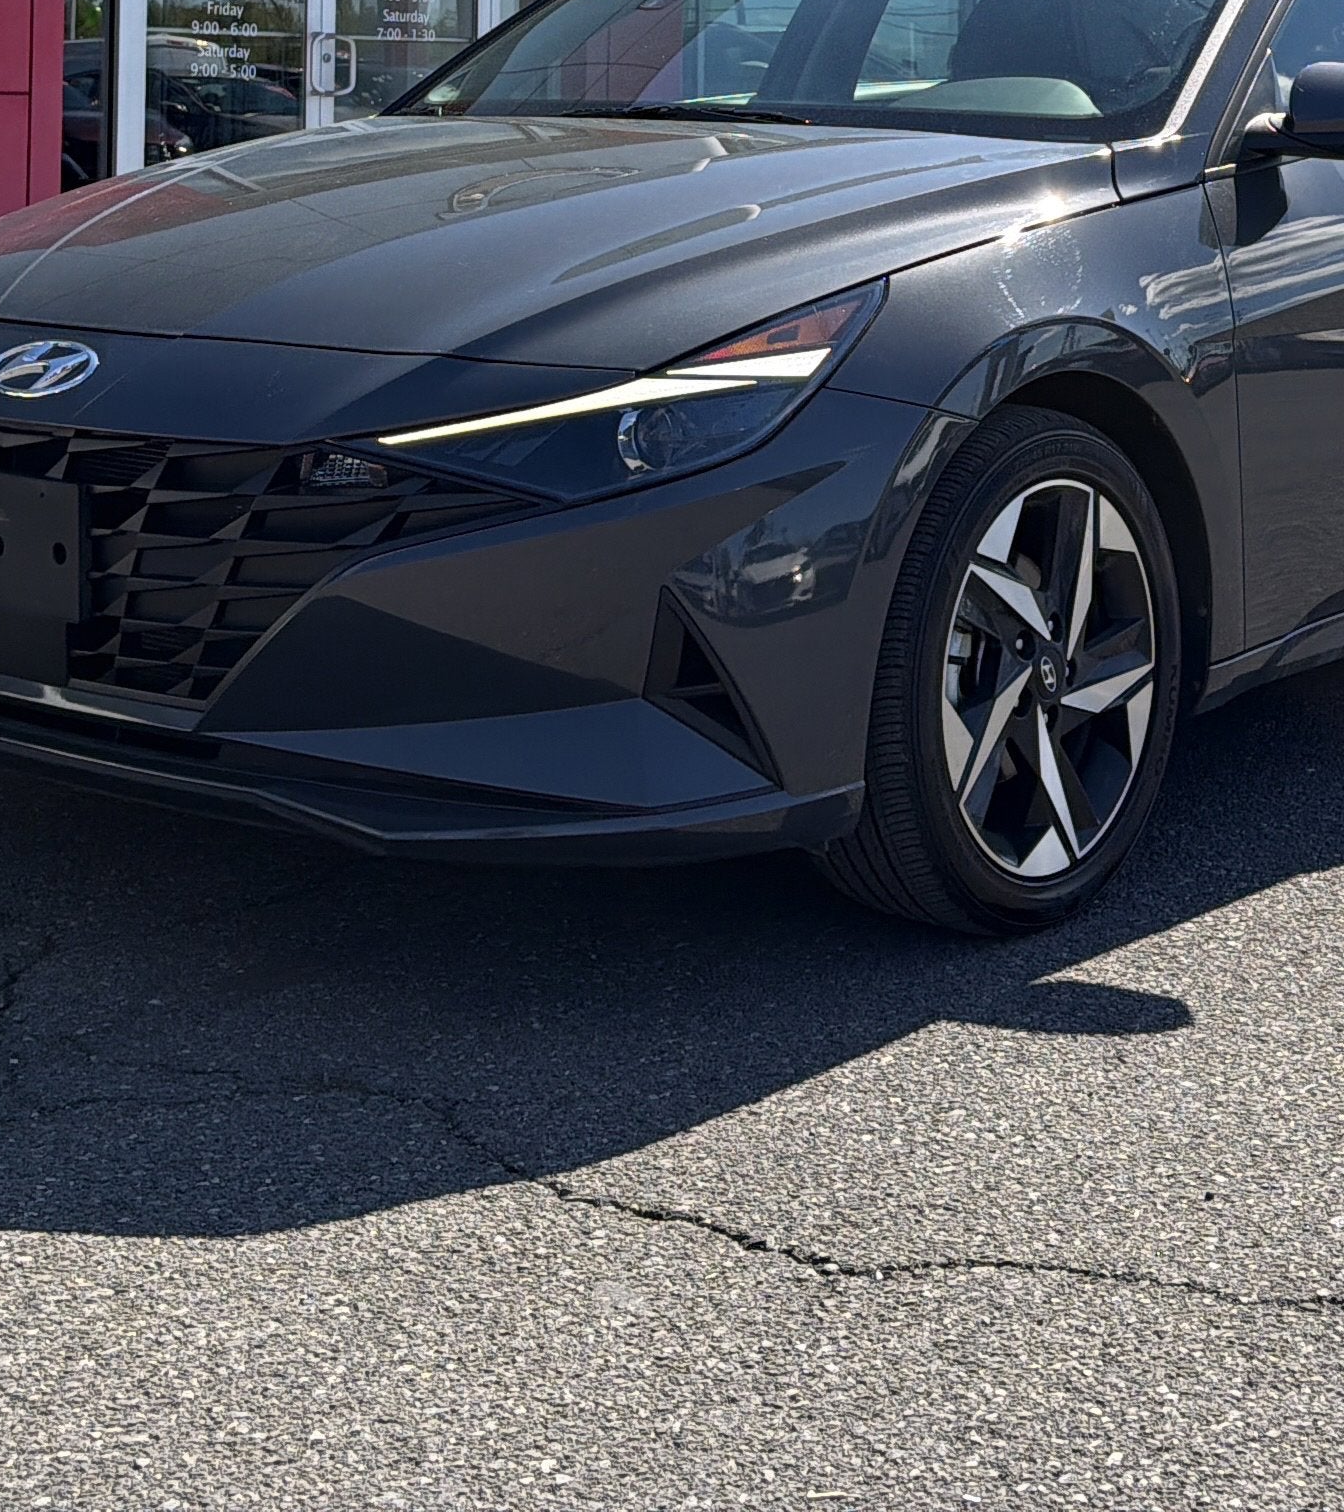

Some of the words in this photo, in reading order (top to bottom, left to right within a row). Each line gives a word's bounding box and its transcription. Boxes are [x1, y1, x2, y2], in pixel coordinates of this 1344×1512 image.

[207, 0, 245, 19] Friday
[382, 9, 430, 26] Saturday
[191, 20, 220, 35] 9:00
[230, 22, 258, 37] 6:00
[376, 27, 402, 41] 7:00
[412, 28, 436, 42] 1:30
[196, 43, 251, 61] Saturday
[190, 62, 218, 78] 9:00
[230, 64, 257, 80] 5:00
